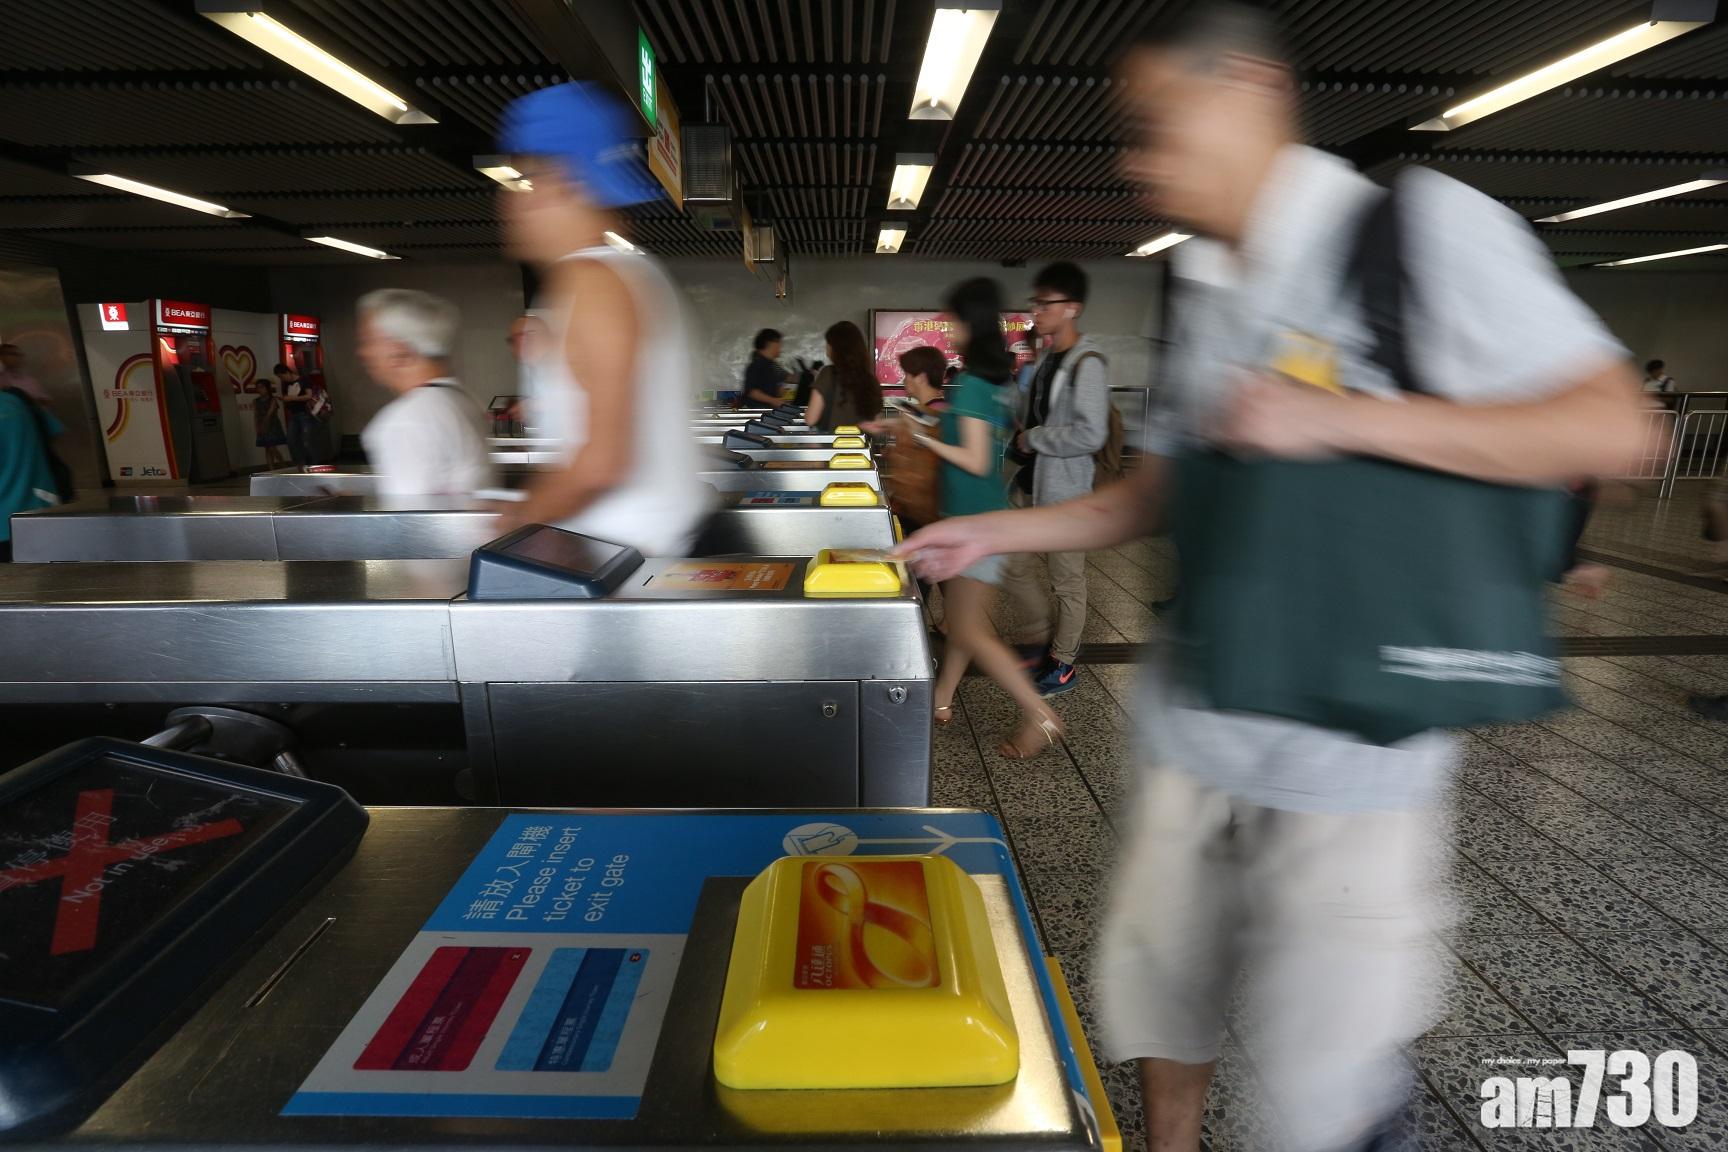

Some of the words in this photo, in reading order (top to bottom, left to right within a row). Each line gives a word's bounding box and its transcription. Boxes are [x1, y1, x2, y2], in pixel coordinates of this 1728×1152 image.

[171, 308, 186, 317] BEA
[61, 873, 114, 904] Not
[104, 861, 134, 877] in
[130, 836, 169, 861] use
[462, 825, 553, 920] 請放入閘機
[505, 867, 557, 921] Please
[541, 826, 582, 863] insert
[543, 876, 586, 922] ticket
[570, 857, 596, 873] to
[584, 891, 614, 922] exit
[601, 854, 631, 887] gate
